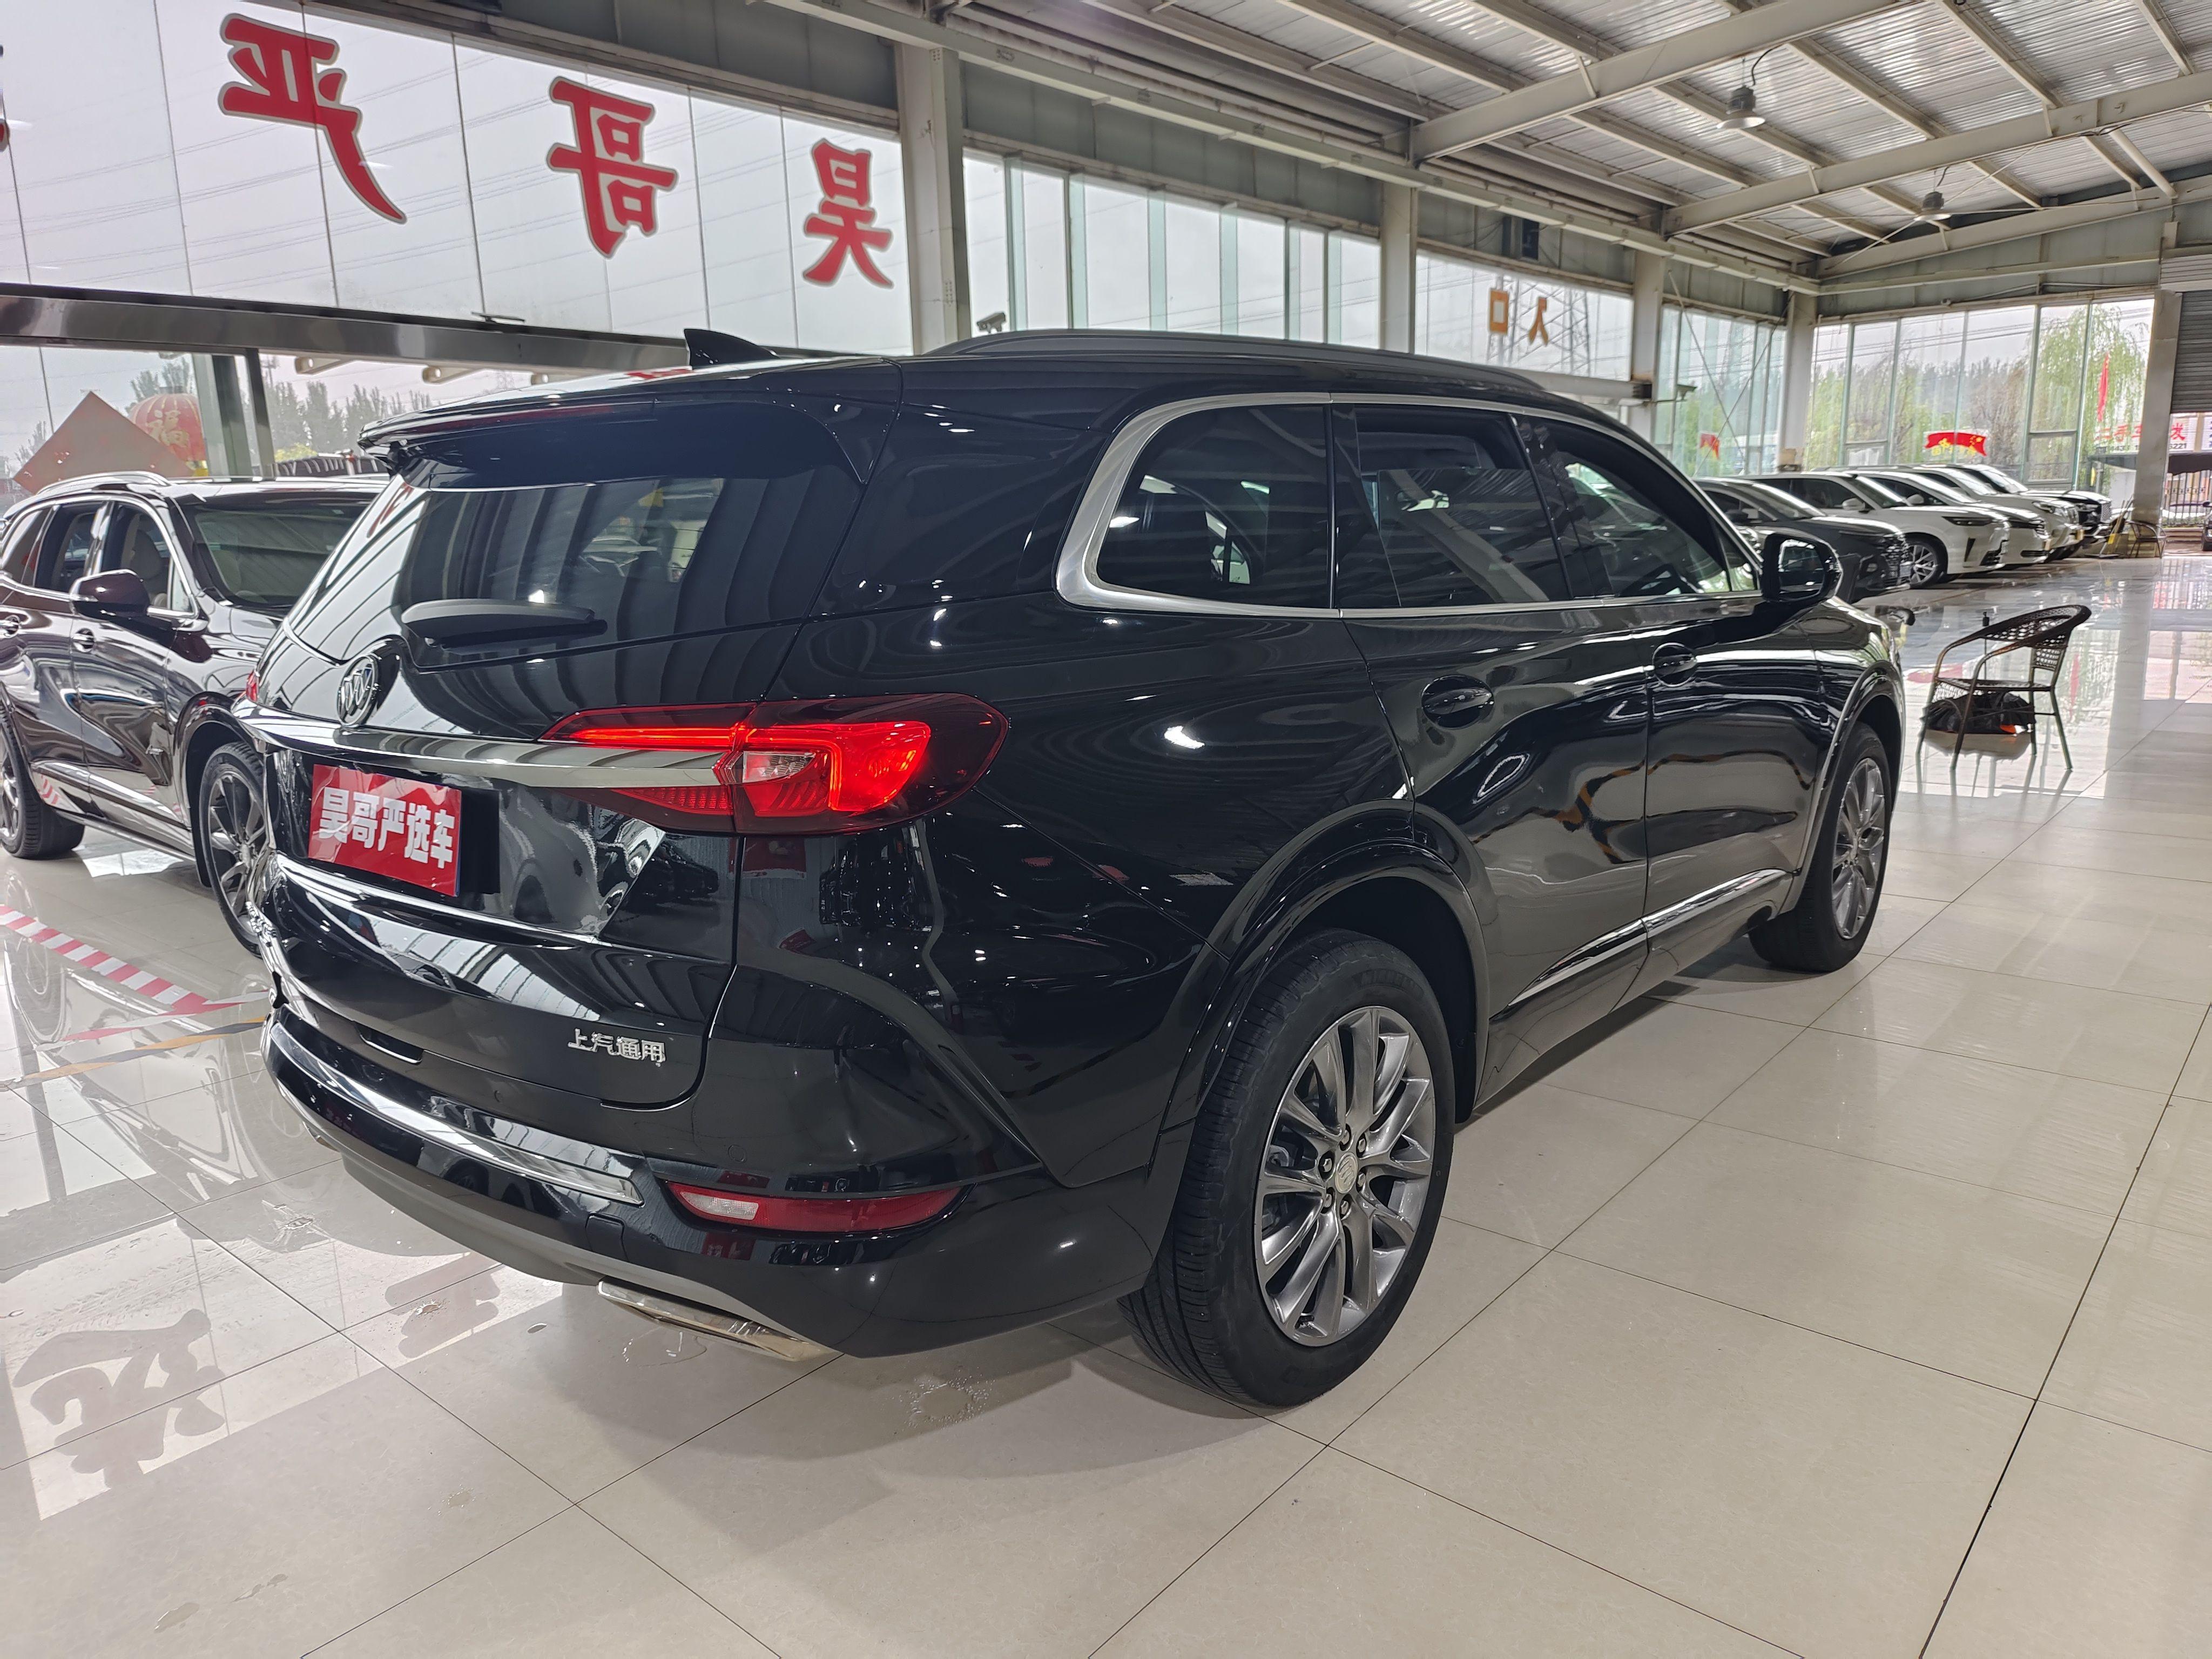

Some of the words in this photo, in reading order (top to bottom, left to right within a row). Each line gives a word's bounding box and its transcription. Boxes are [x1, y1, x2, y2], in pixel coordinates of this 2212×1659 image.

[319, 786, 456, 869] 昊哥严选车
[568, 1028, 666, 1063] 上汽通用
